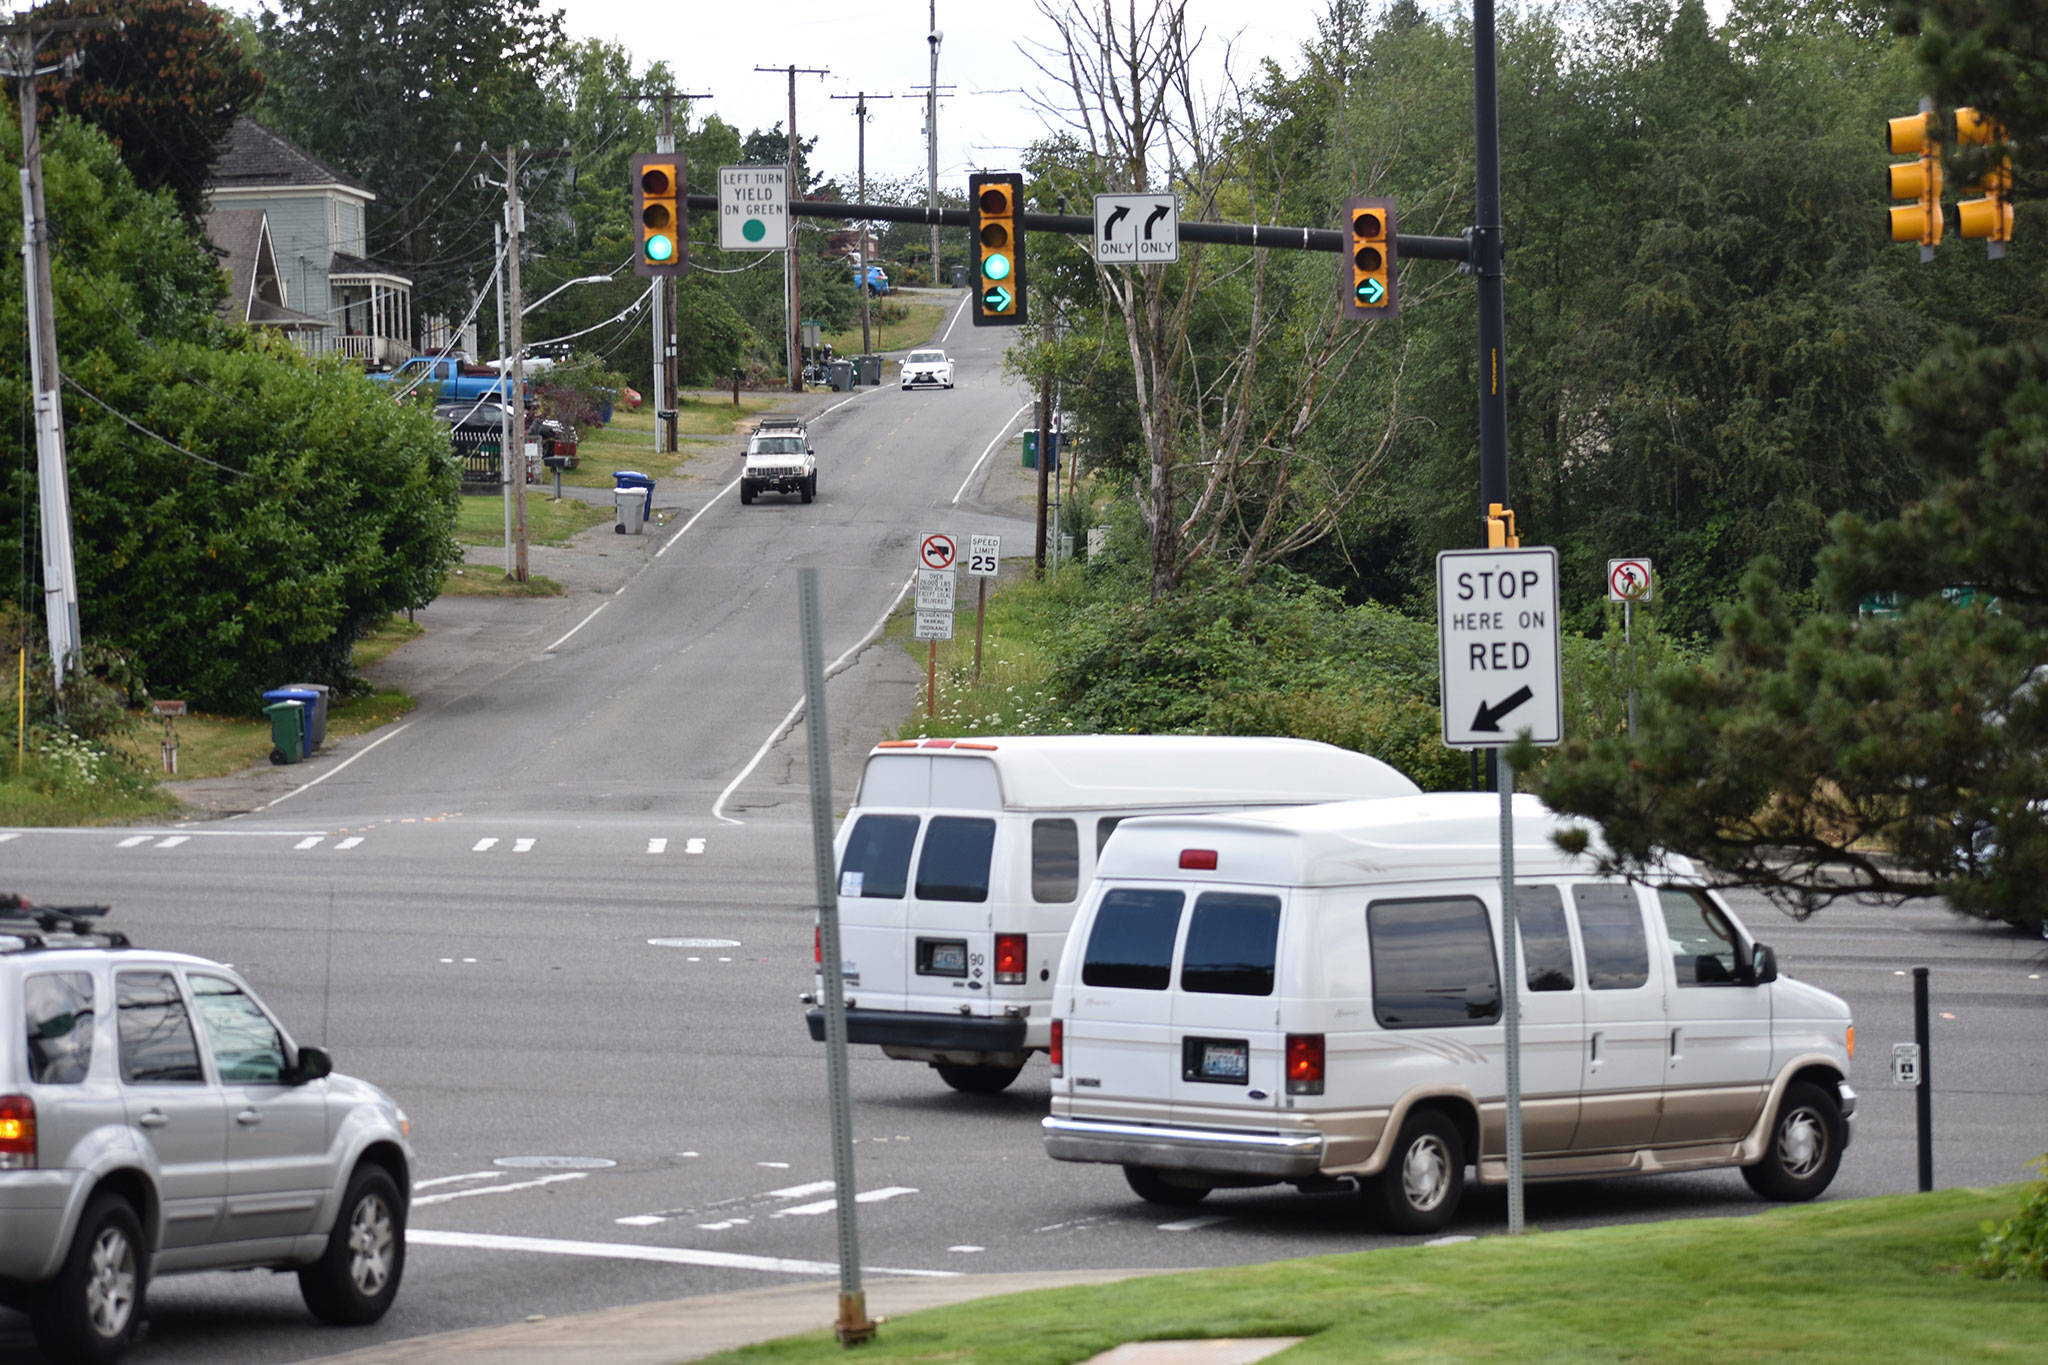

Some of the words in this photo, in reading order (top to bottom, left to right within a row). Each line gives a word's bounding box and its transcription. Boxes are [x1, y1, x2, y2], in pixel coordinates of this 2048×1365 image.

[723, 174, 749, 185] LEFT
[755, 173, 782, 184] TURN
[734, 188, 773, 201] YIELD
[724, 204, 739, 216] ON
[746, 204, 783, 216] GREEN
[1100, 242, 1133, 255] ONLY
[1140, 241, 1173, 254] ONLY
[972, 538, 999, 546] SPEED
[974, 547, 995, 555] LIMIT
[971, 555, 996, 572] 25
[1457, 570, 1539, 601] STOP
[1453, 612, 1504, 631] HERE
[1518, 611, 1545, 630] ON
[1469, 642, 1530, 671] RED
[969, 952, 984, 967] 90
